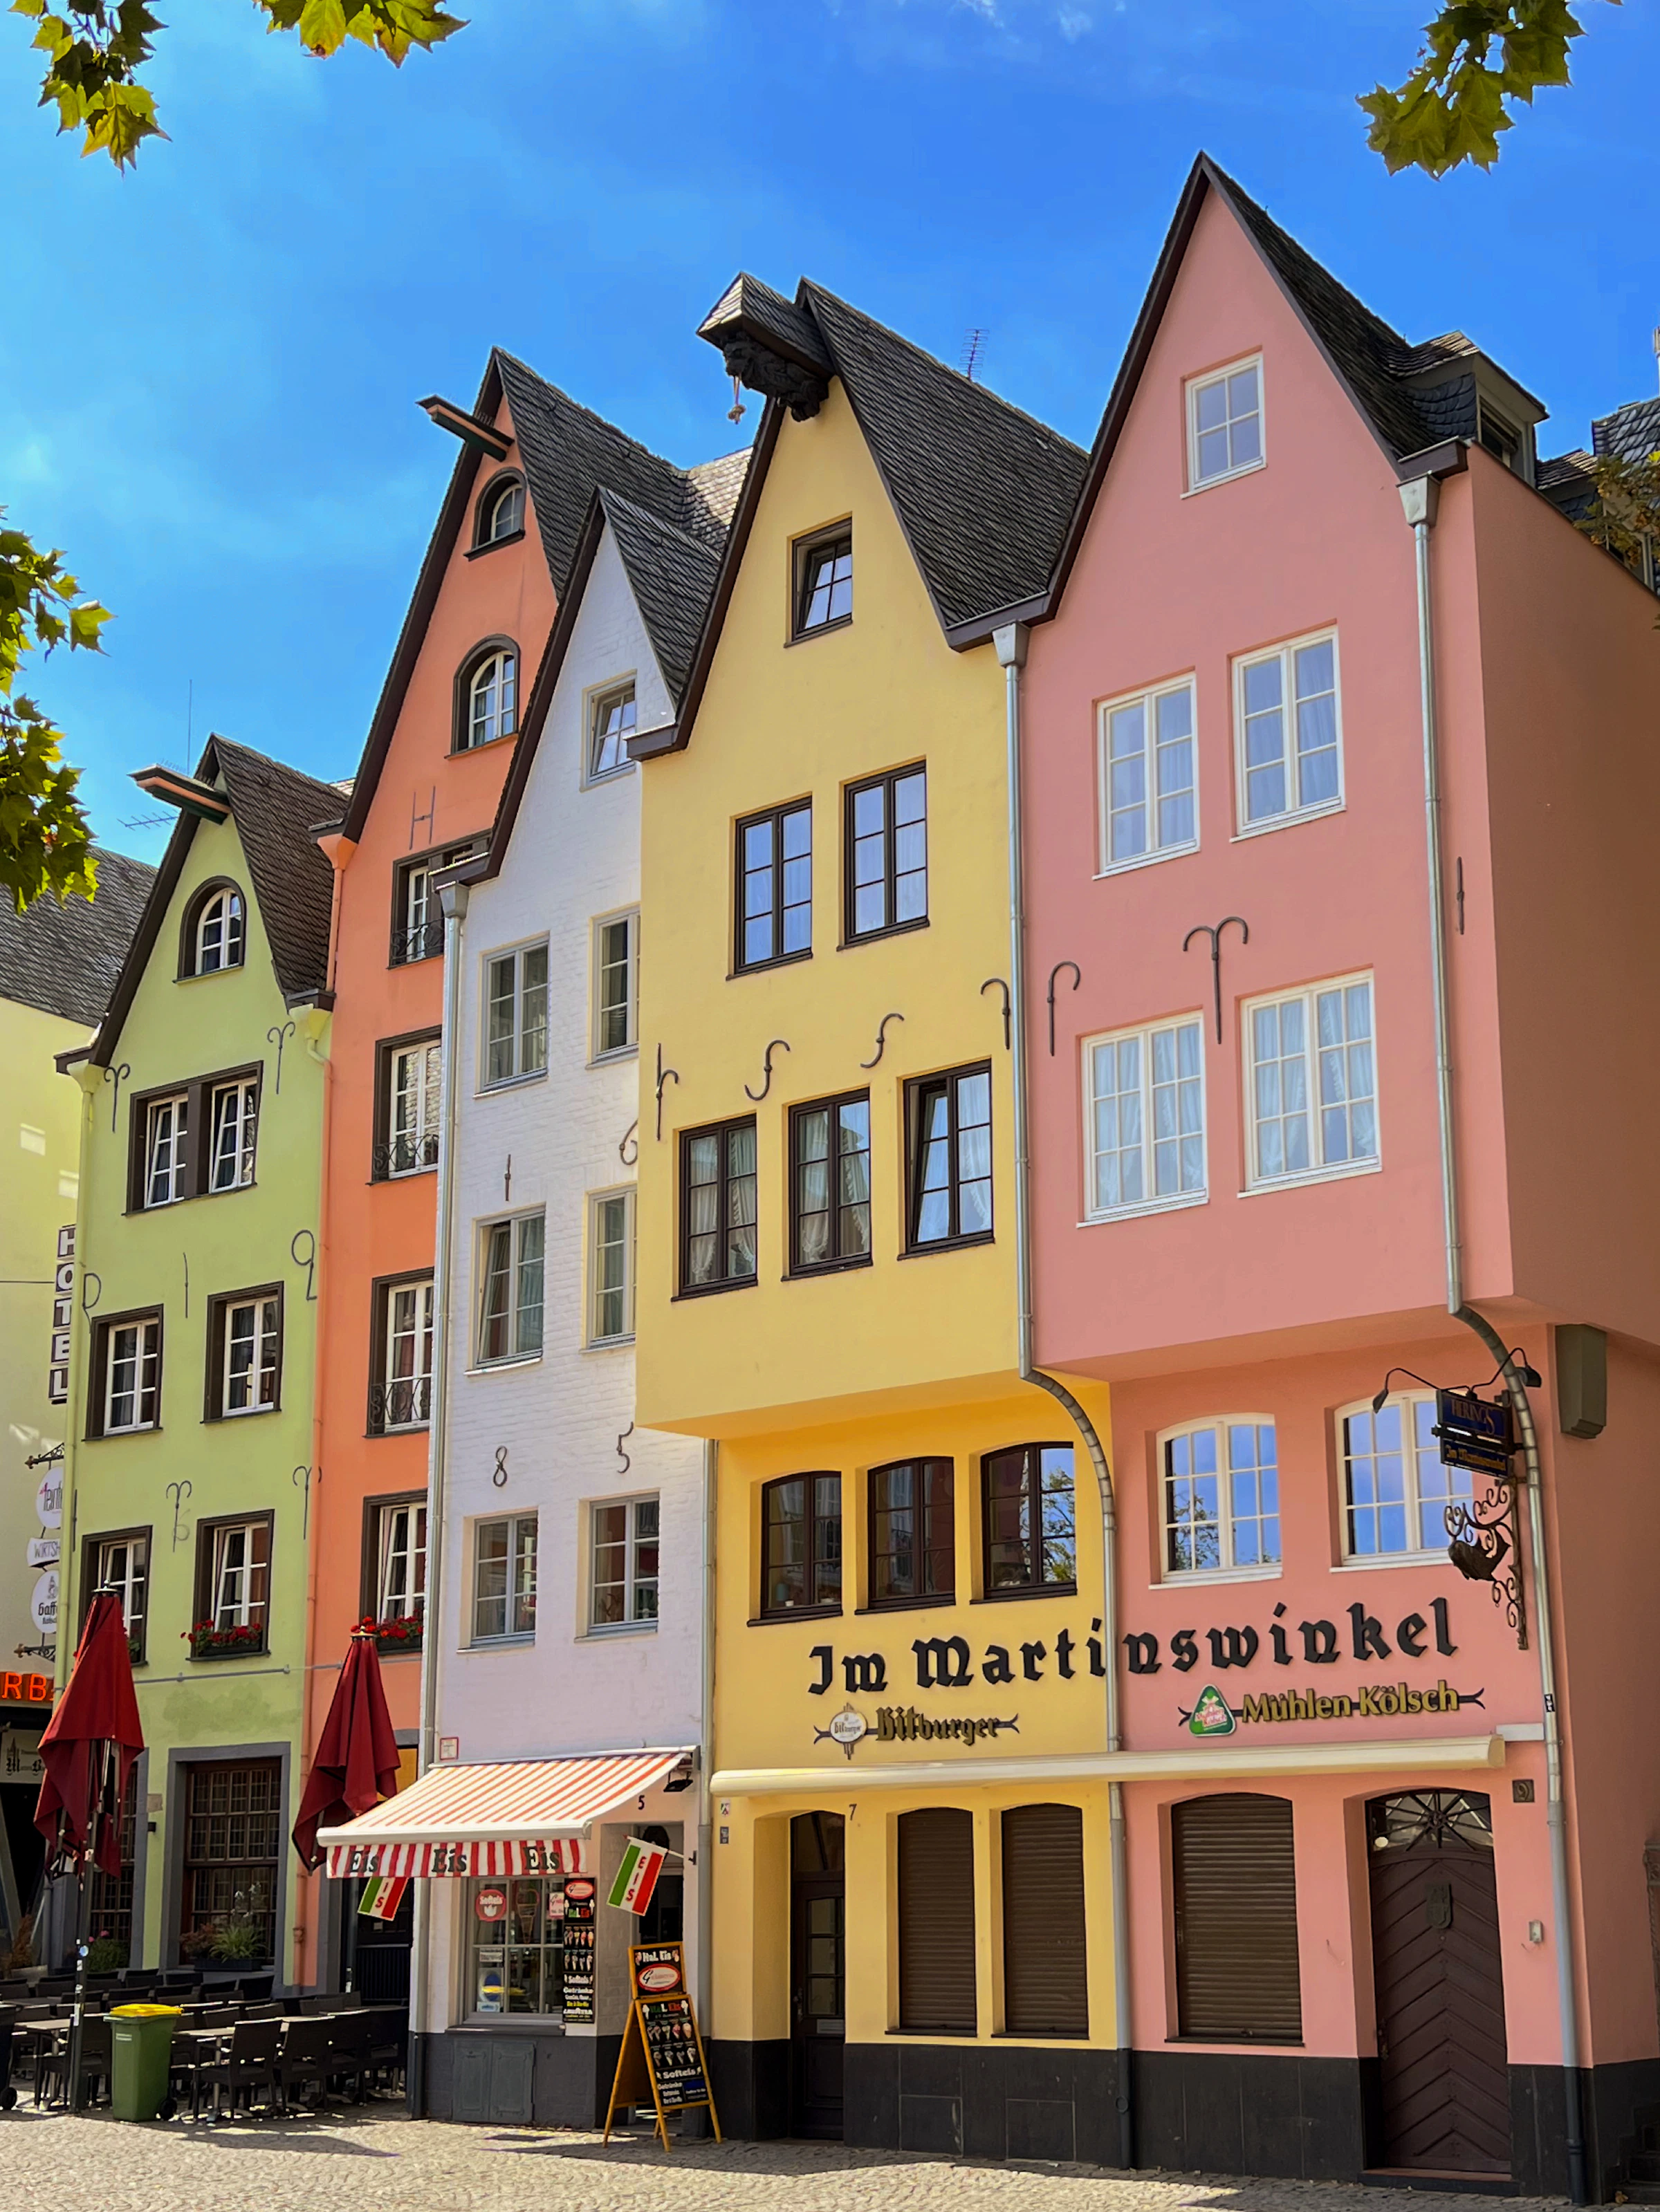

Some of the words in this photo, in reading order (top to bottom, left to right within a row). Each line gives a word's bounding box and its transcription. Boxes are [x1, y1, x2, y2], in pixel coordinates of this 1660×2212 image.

[53, 1229, 75, 1396] HOTEL
[38, 1601, 57, 1616] Gaff
[2, 1672, 53, 1701] RB
[1242, 1688, 1352, 1723] Mühlen
[1359, 1680, 1459, 1715] Kölsch
[876, 1705, 1000, 1746] Bitburger
[638, 1795, 645, 1810] 5
[1518, 1782, 1530, 1802] 9
[849, 1803, 857, 1821] 7
[349, 1850, 379, 1873] Eis
[432, 1848, 468, 1873] Eis
[523, 1846, 560, 1871] Eis
[625, 1856, 647, 1903] EIS
